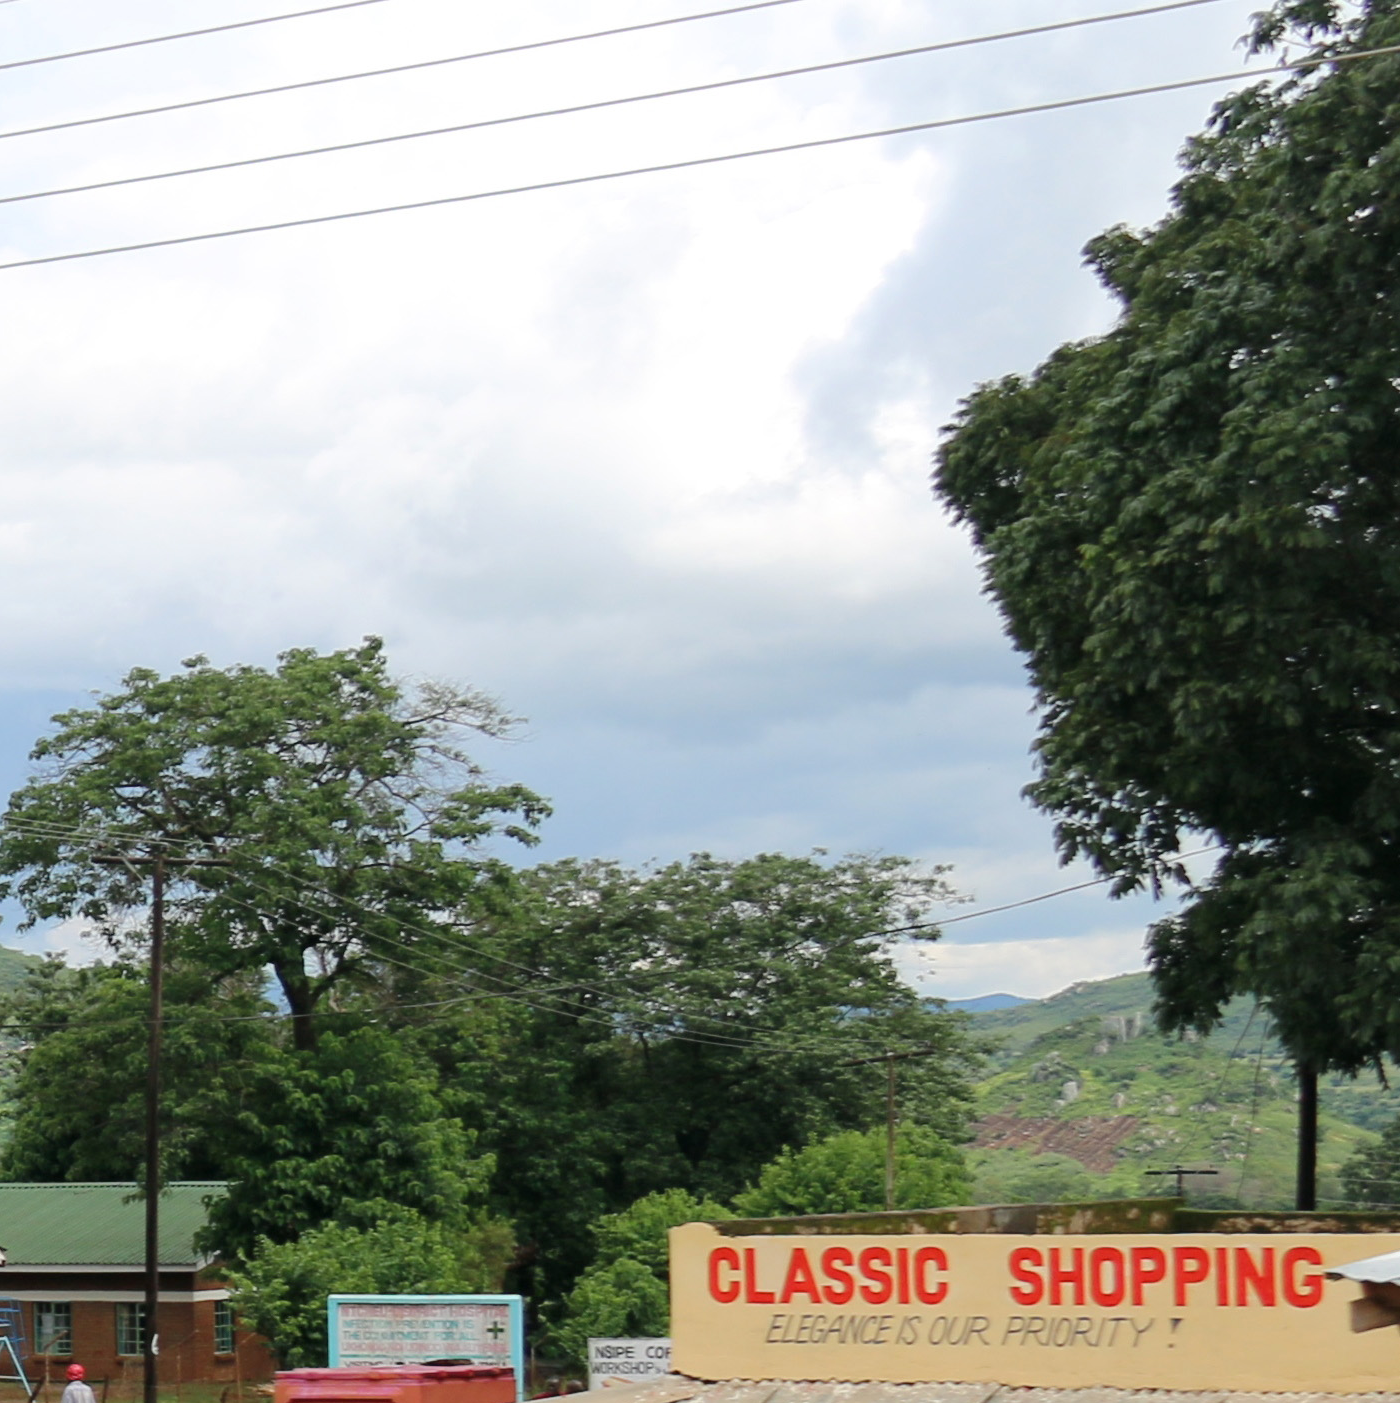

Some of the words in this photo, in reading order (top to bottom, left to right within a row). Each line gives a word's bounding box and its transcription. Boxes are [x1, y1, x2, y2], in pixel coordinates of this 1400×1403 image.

[707, 1246, 949, 1305] CLASSIC
[1008, 1246, 1325, 1308] SHOPPING
[765, 1313, 892, 1346] ELEGANCE
[896, 1315, 920, 1346] IS
[929, 1315, 991, 1347] OUR
[1000, 1315, 1154, 1348] PRIORITY
[595, 1345, 635, 1359] NSIPE
[591, 1361, 654, 1375] WORKSHOP
